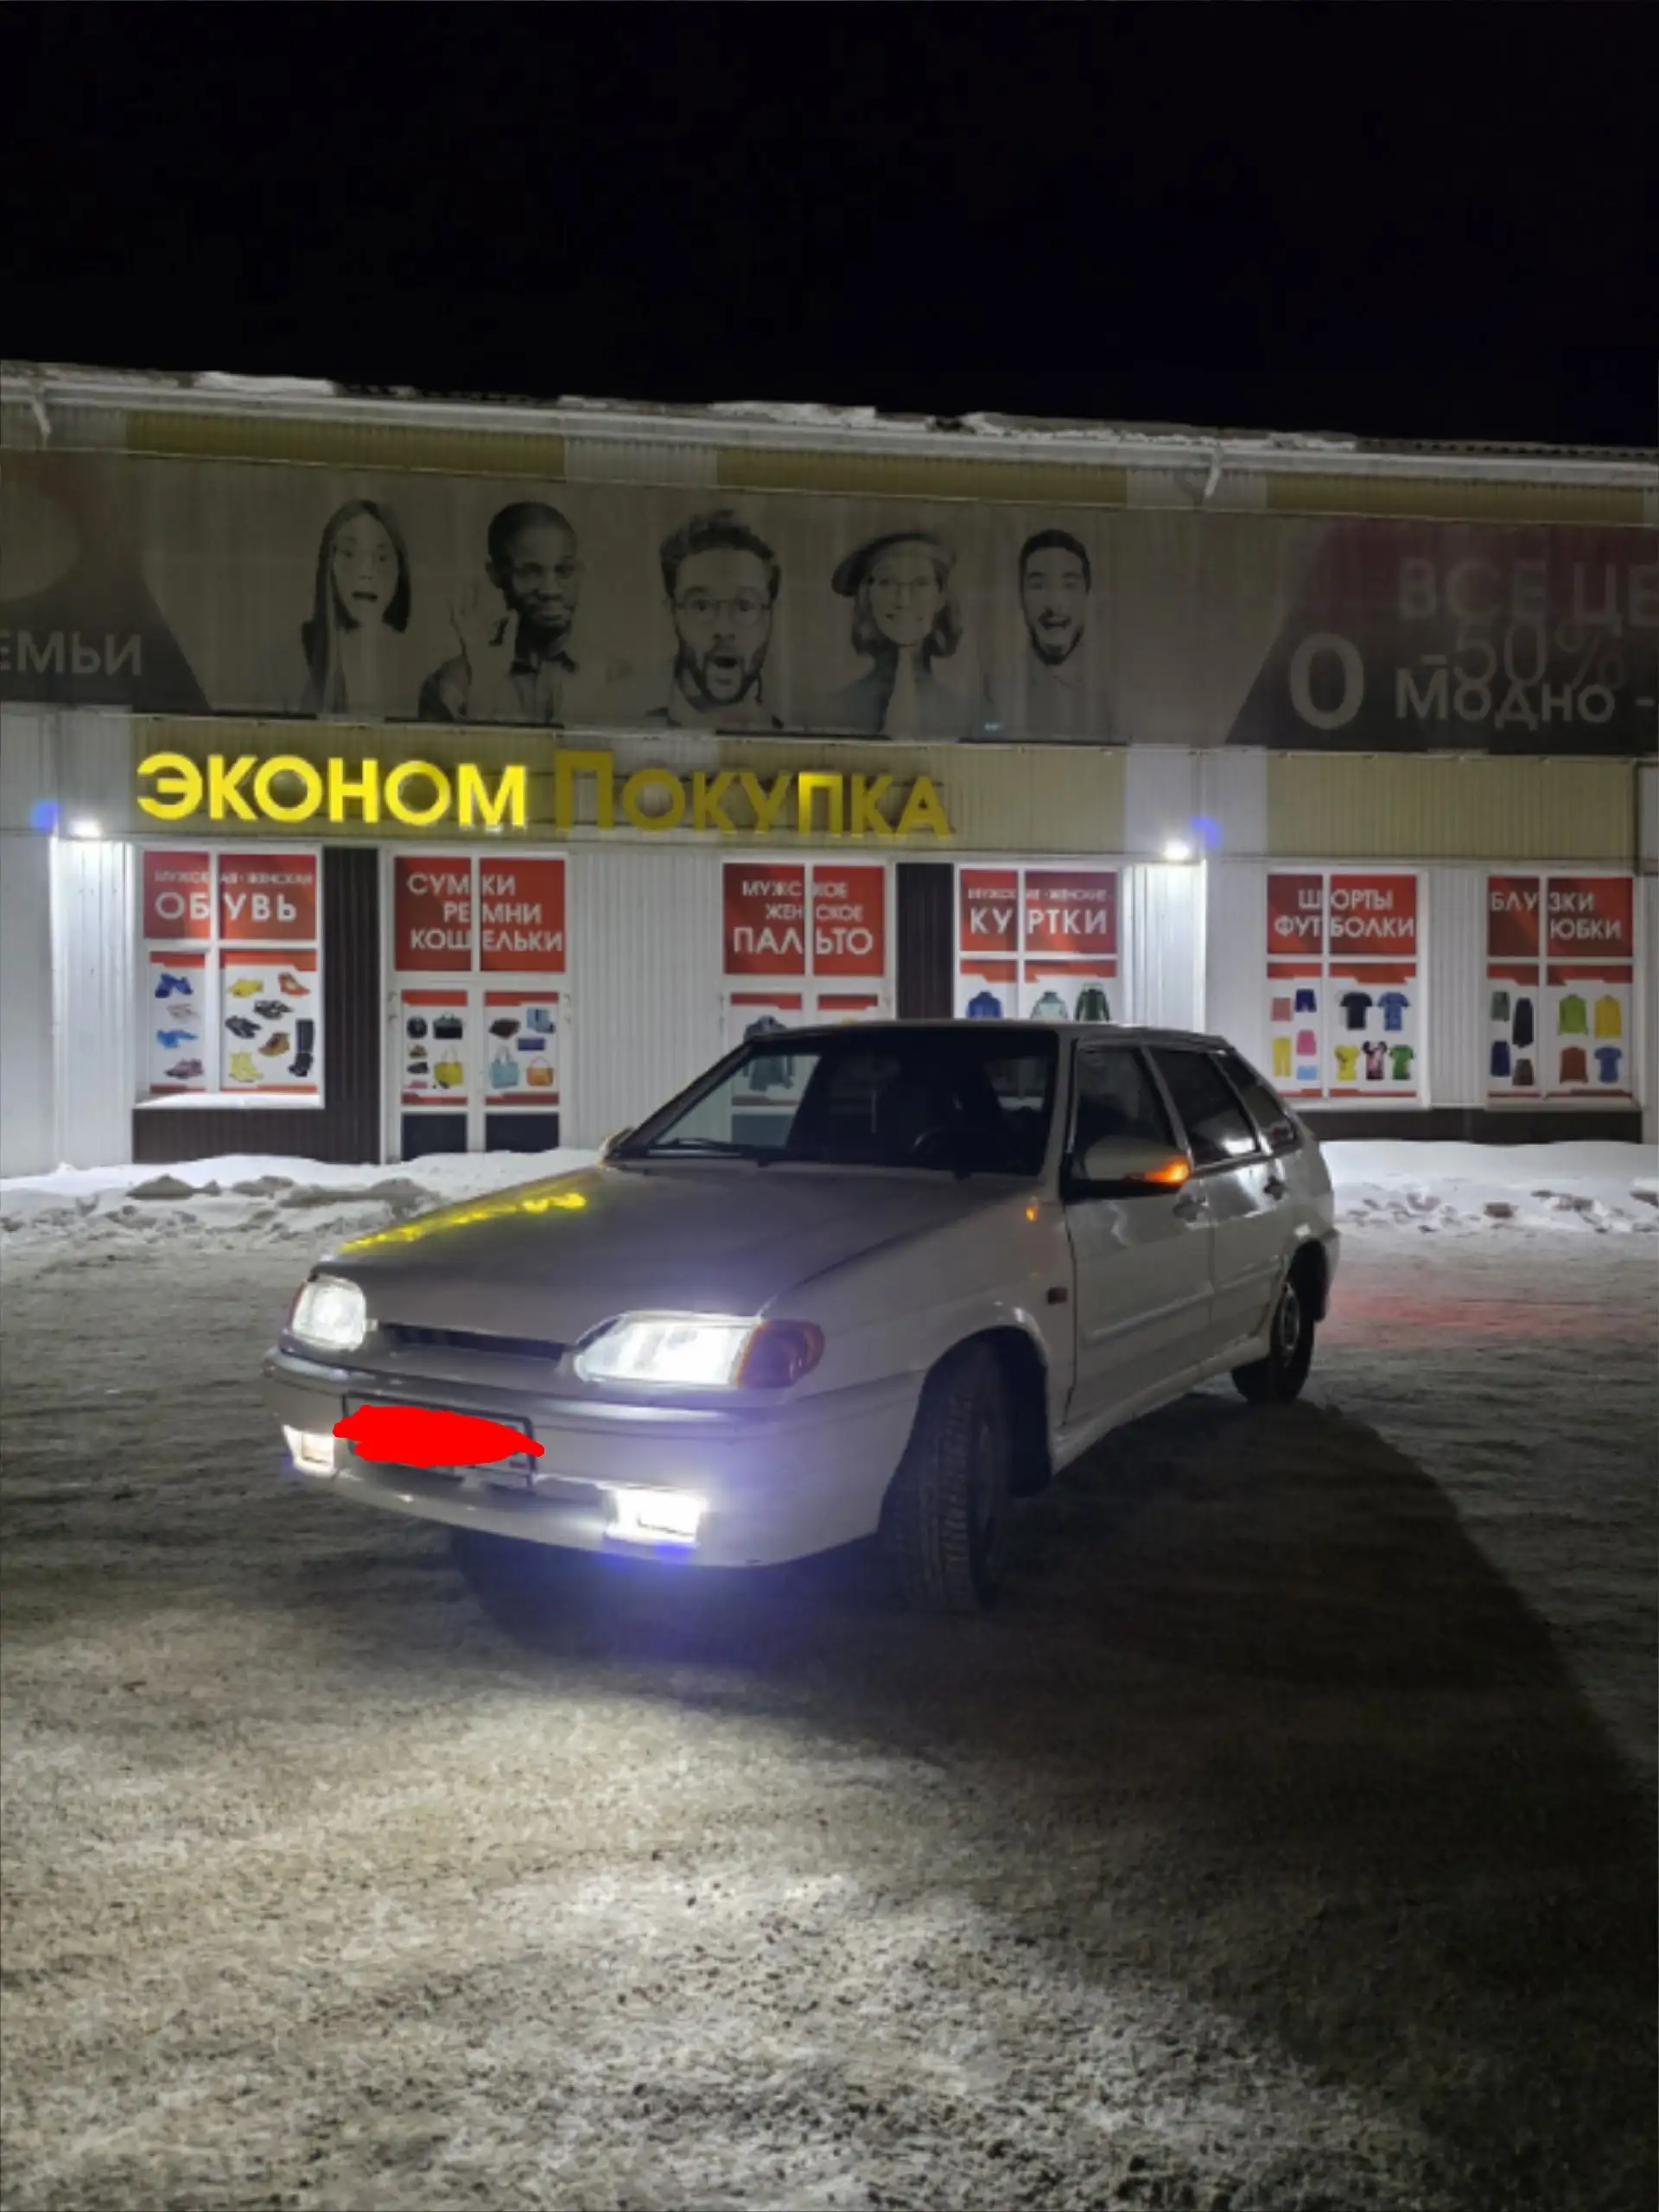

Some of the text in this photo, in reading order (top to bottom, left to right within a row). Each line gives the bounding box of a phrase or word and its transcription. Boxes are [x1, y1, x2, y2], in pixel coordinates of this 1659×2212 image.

[1398, 557, 1547, 621] ВСЕ
[137, 749, 954, 836] ЭКОНОМ ПОКУПКА
[407, 873, 516, 896] СУМКИ
[155, 892, 296, 922] ОБУВЬ
[1297, 889, 1394, 910] ШОРТЫ
[1491, 891, 1595, 912] БЛУЗКИ
[443, 900, 542, 924] РЕМНИ
[970, 908, 1107, 934] КУРТКИ
[1274, 915, 1414, 938] ФУТБОЛКИ
[1550, 918, 1622, 940] ЮБКИ
[410, 928, 562, 951] КОШЕЛЬКИ
[734, 927, 874, 955] ПАЛЬТО
